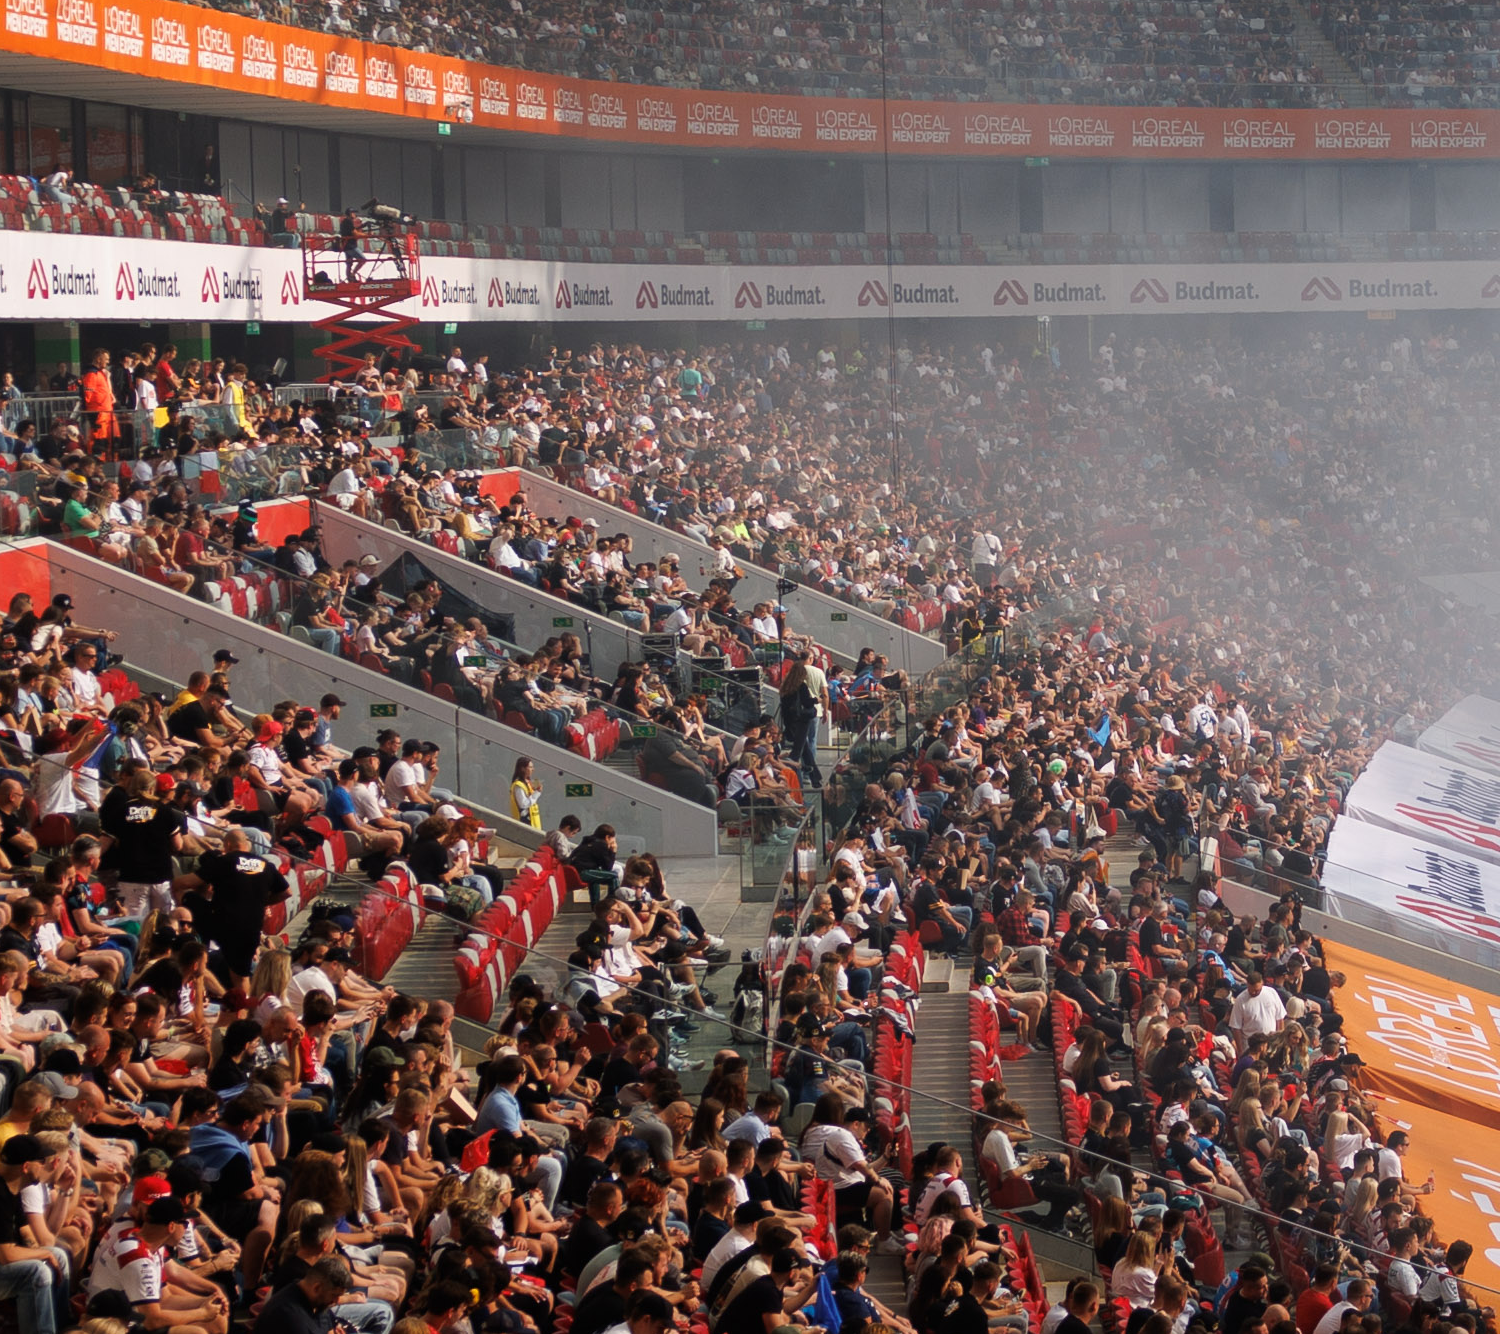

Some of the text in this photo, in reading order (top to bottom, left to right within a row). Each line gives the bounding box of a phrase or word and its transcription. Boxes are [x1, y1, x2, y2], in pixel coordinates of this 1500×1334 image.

[53, 265, 98, 295] Budmat.
[138, 268, 180, 297] Budmat.
[224, 272, 262, 300] Budmat.
[1176, 281, 1259, 300] Budmat.
[442, 280, 477, 304] Budmat.
[574, 284, 613, 305] Budmat.
[767, 285, 825, 305] Budmat.
[1034, 283, 1105, 302] Budmat.
